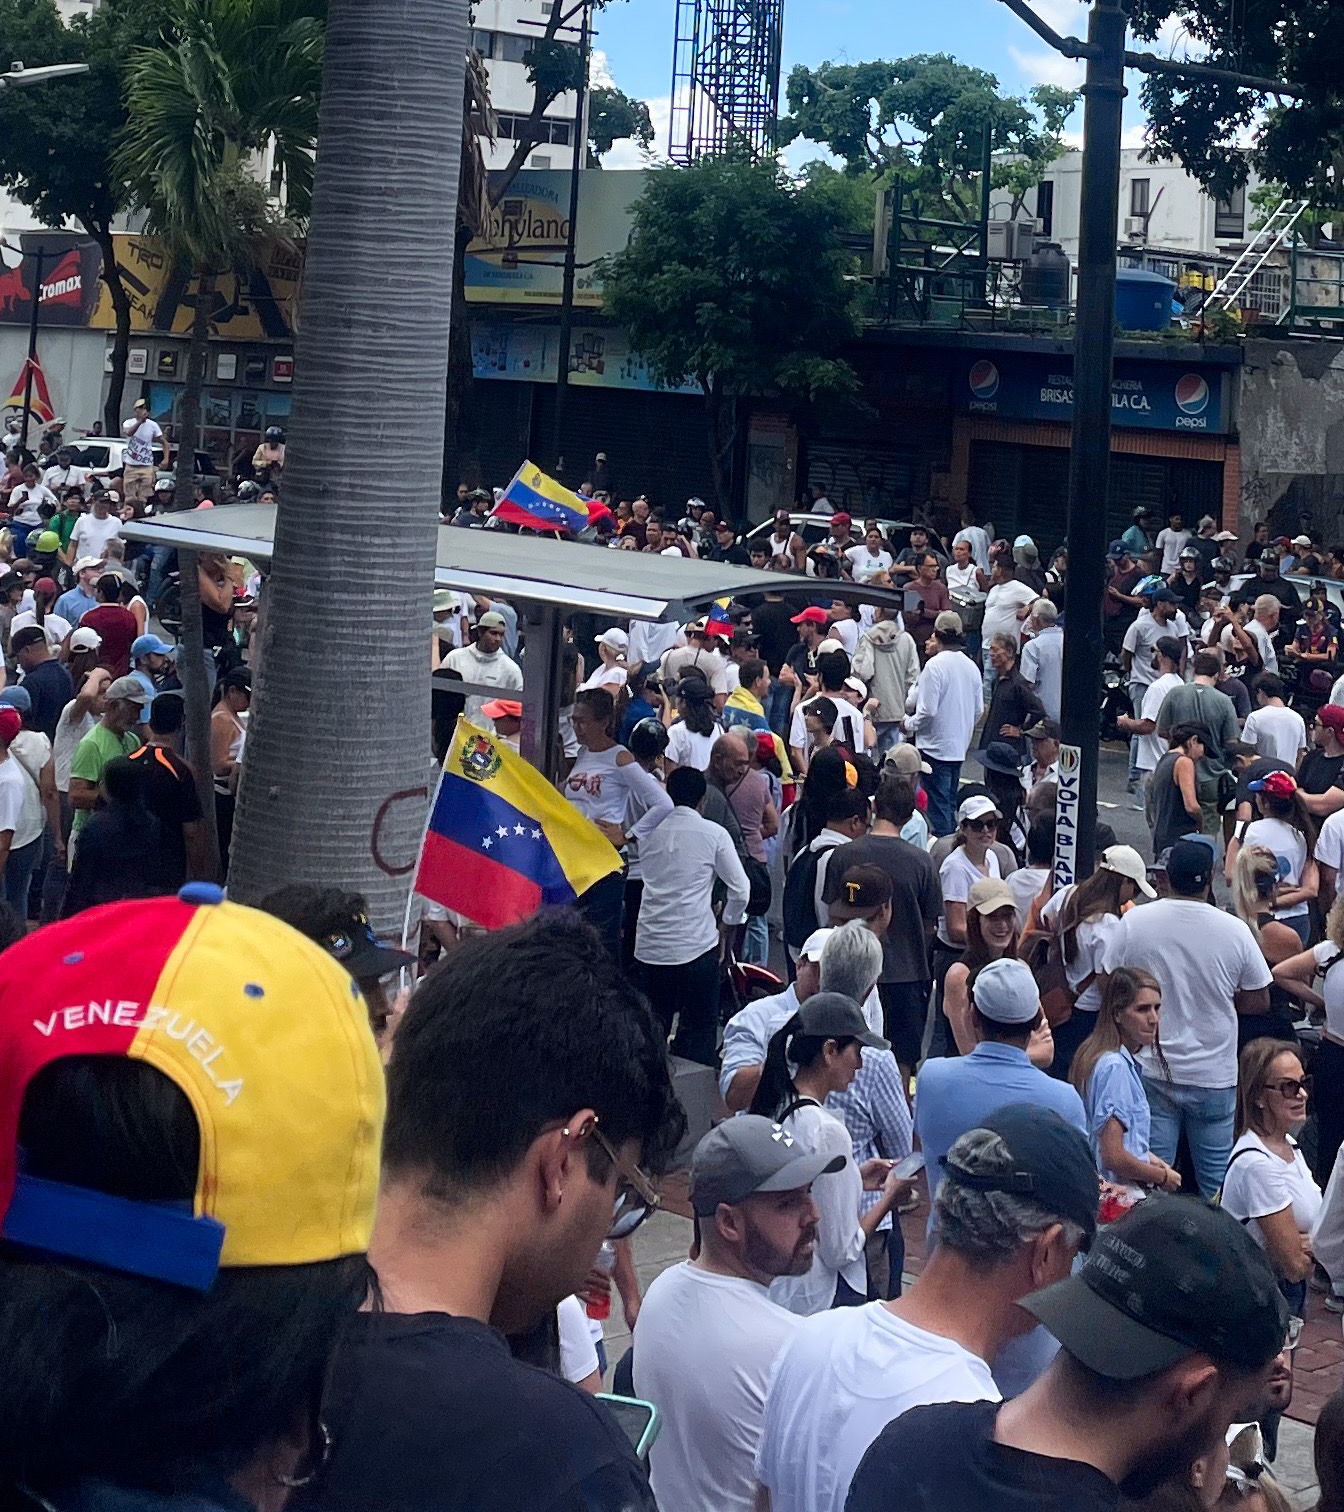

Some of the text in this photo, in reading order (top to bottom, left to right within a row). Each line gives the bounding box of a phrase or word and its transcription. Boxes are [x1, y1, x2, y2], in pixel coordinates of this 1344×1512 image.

[969, 401, 998, 414] pepsi
[1175, 416, 1207, 429] pepsi
[1056, 775, 1078, 886] VOTA BLAN
[34, 999, 244, 1106] VENEZUELA
